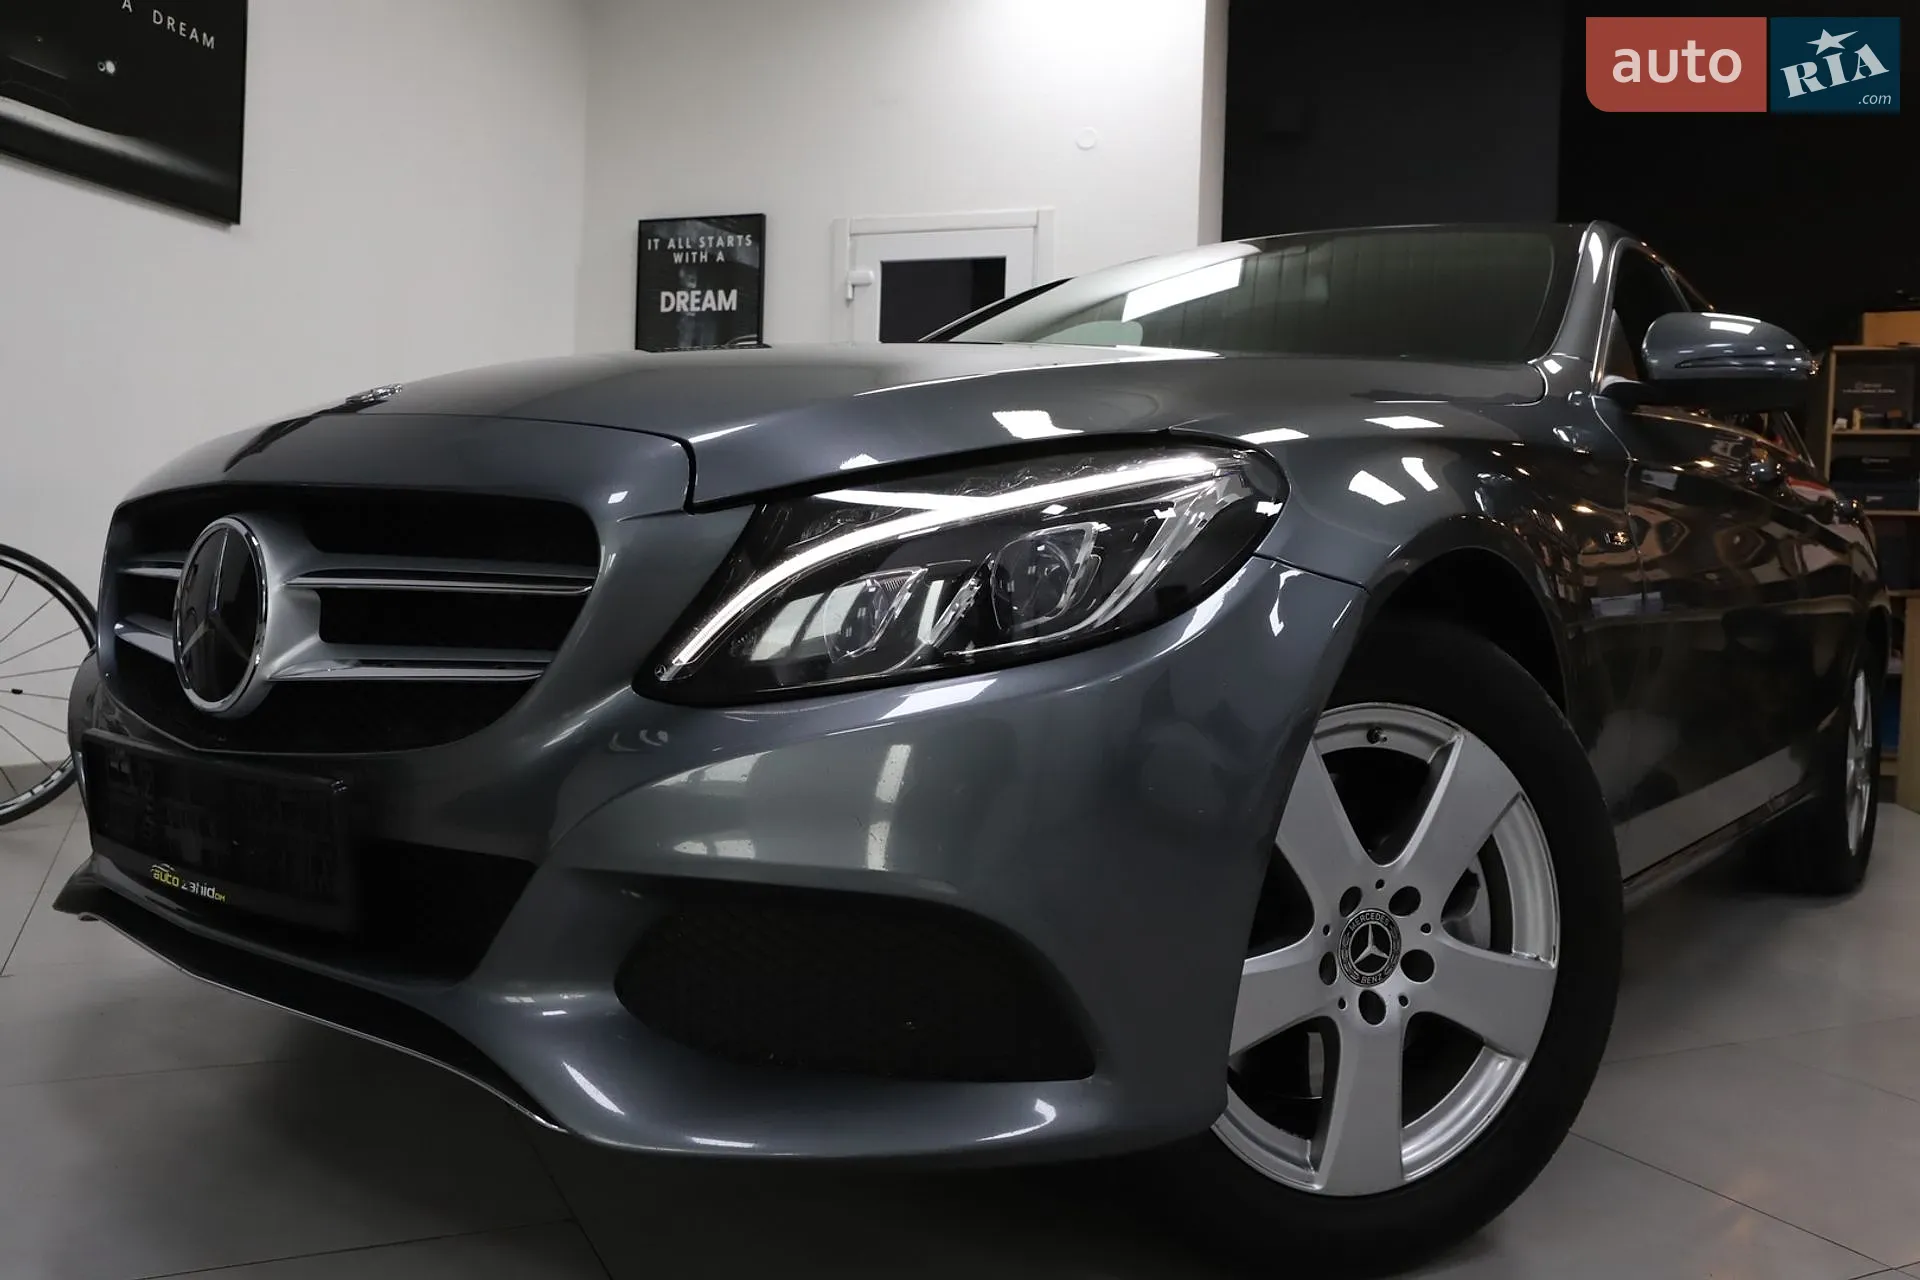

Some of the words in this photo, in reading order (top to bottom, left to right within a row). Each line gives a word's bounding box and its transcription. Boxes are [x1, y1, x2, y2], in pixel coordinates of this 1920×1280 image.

[121, 0, 133, 13] A
[152, 9, 216, 49] DREAM
[647, 238, 661, 251] IT
[667, 237, 692, 250] ALL
[699, 234, 753, 248] STARTS
[673, 251, 708, 264] WITH
[716, 250, 725, 263] A
[660, 289, 738, 313] DREAM
[1348, 912, 1389, 931] MERCEDES
[1360, 973, 1383, 984] BENZ
